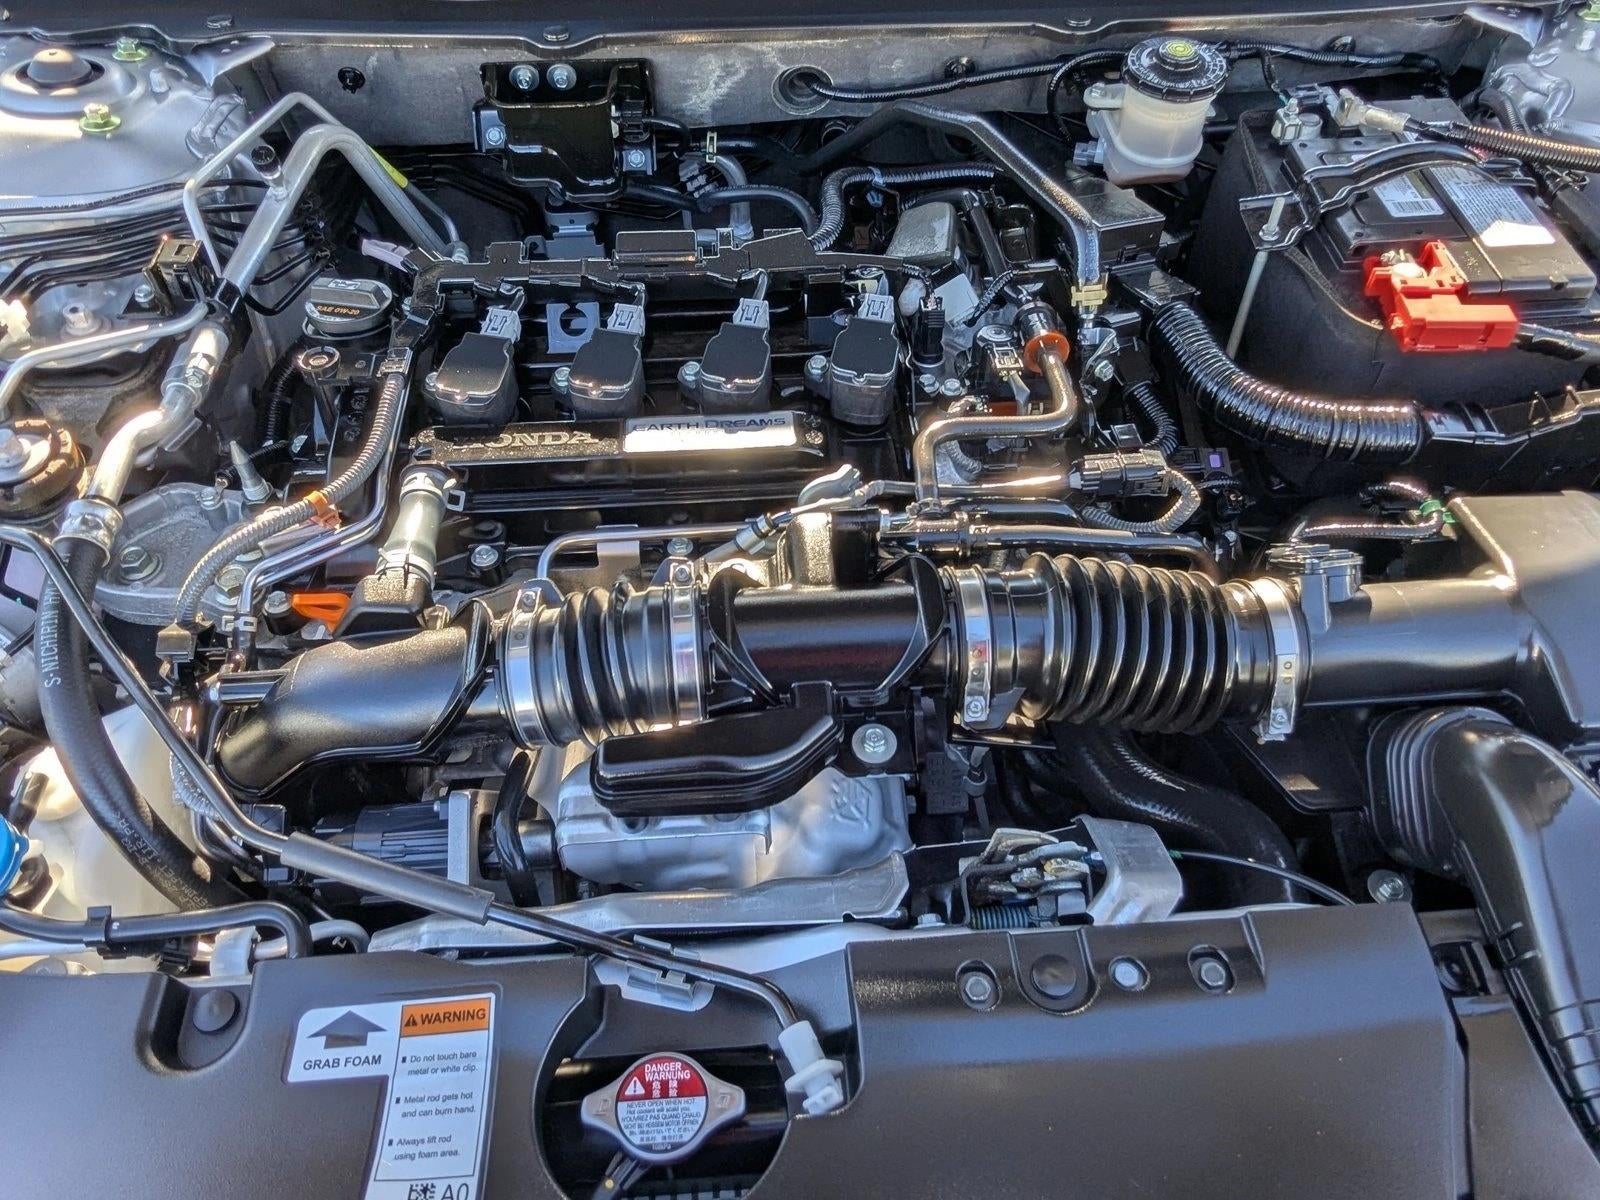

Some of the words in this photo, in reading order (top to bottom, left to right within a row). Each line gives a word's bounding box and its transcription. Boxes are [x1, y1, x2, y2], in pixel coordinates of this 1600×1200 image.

[316, 305, 334, 313] SAE
[633, 421, 699, 432] EARTH
[705, 417, 786, 429] DREAMS
[420, 1008, 487, 1026] WARNING
[302, 1057, 341, 1072] GRAB
[344, 1054, 383, 1067] FOAM
[410, 1055, 421, 1063] Do
[423, 1054, 436, 1062] not
[437, 1052, 457, 1061] touch
[460, 1051, 477, 1060] bare
[408, 1067, 429, 1076] metal
[441, 1065, 461, 1074] white
[462, 1064, 479, 1073] clip.
[645, 1061, 682, 1072] DANGER
[645, 1070, 691, 1082] WARNUNG
[404, 1094, 425, 1104] Metal
[427, 1094, 440, 1102] rod
[442, 1093, 459, 1103] gets
[460, 1091, 473, 1100] hot
[626, 1101, 647, 1109] NEVER
[401, 1108, 418, 1118] and
[418, 1108, 433, 1117] can
[435, 1106, 453, 1116] burn
[396, 1137, 425, 1147] Always
[427, 1135, 437, 1144] lift
[438, 1134, 452, 1143] rod
[394, 1152, 416, 1162] using
[418, 1150, 439, 1159] foam
